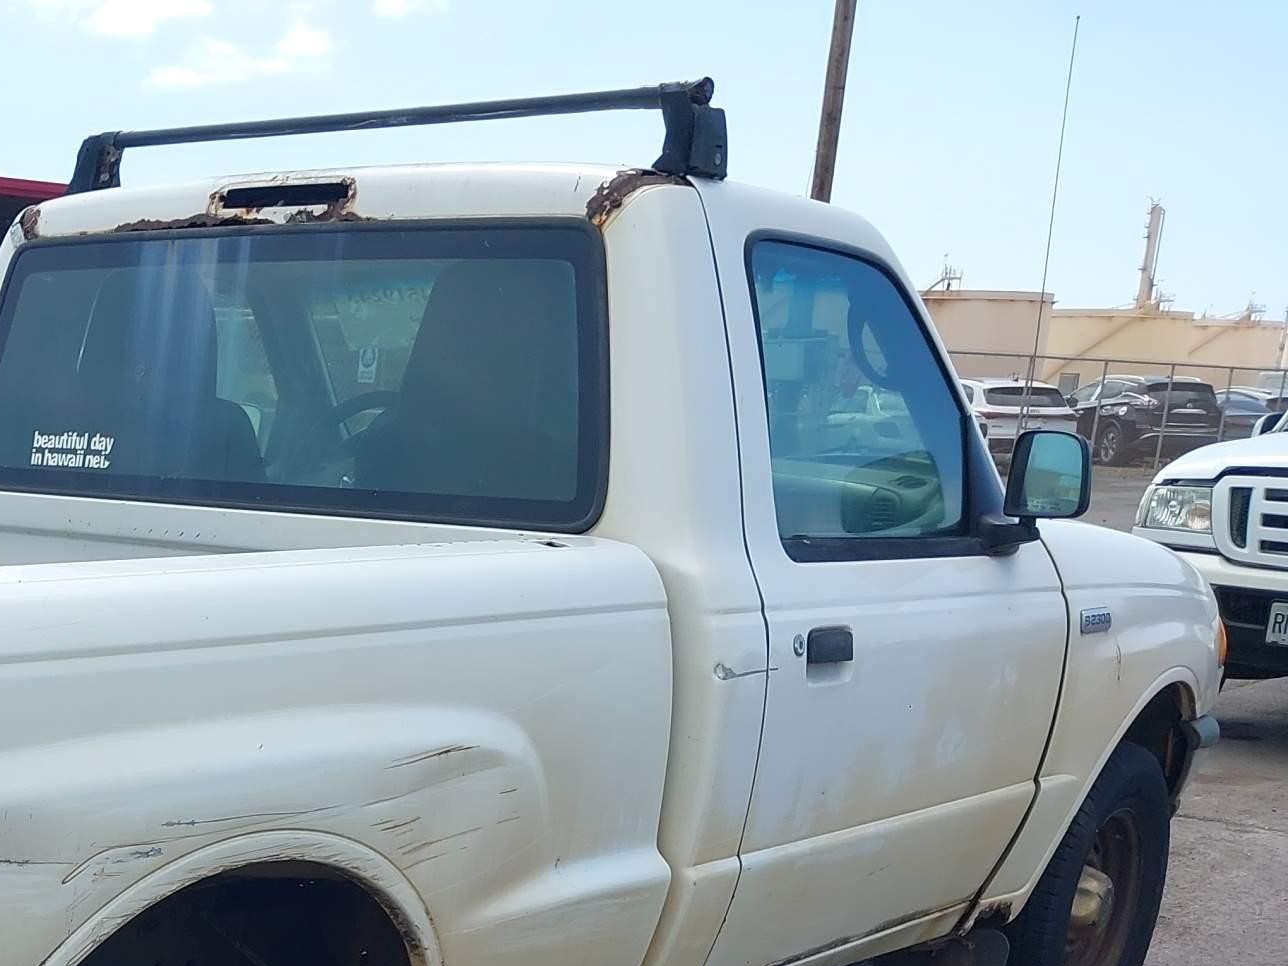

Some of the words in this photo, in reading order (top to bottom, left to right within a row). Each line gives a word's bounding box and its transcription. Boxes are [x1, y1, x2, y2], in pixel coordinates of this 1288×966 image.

[33, 431, 89, 449] beautiful
[90, 433, 114, 454] day
[31, 449, 42, 465] in
[43, 449, 84, 467] hawaii
